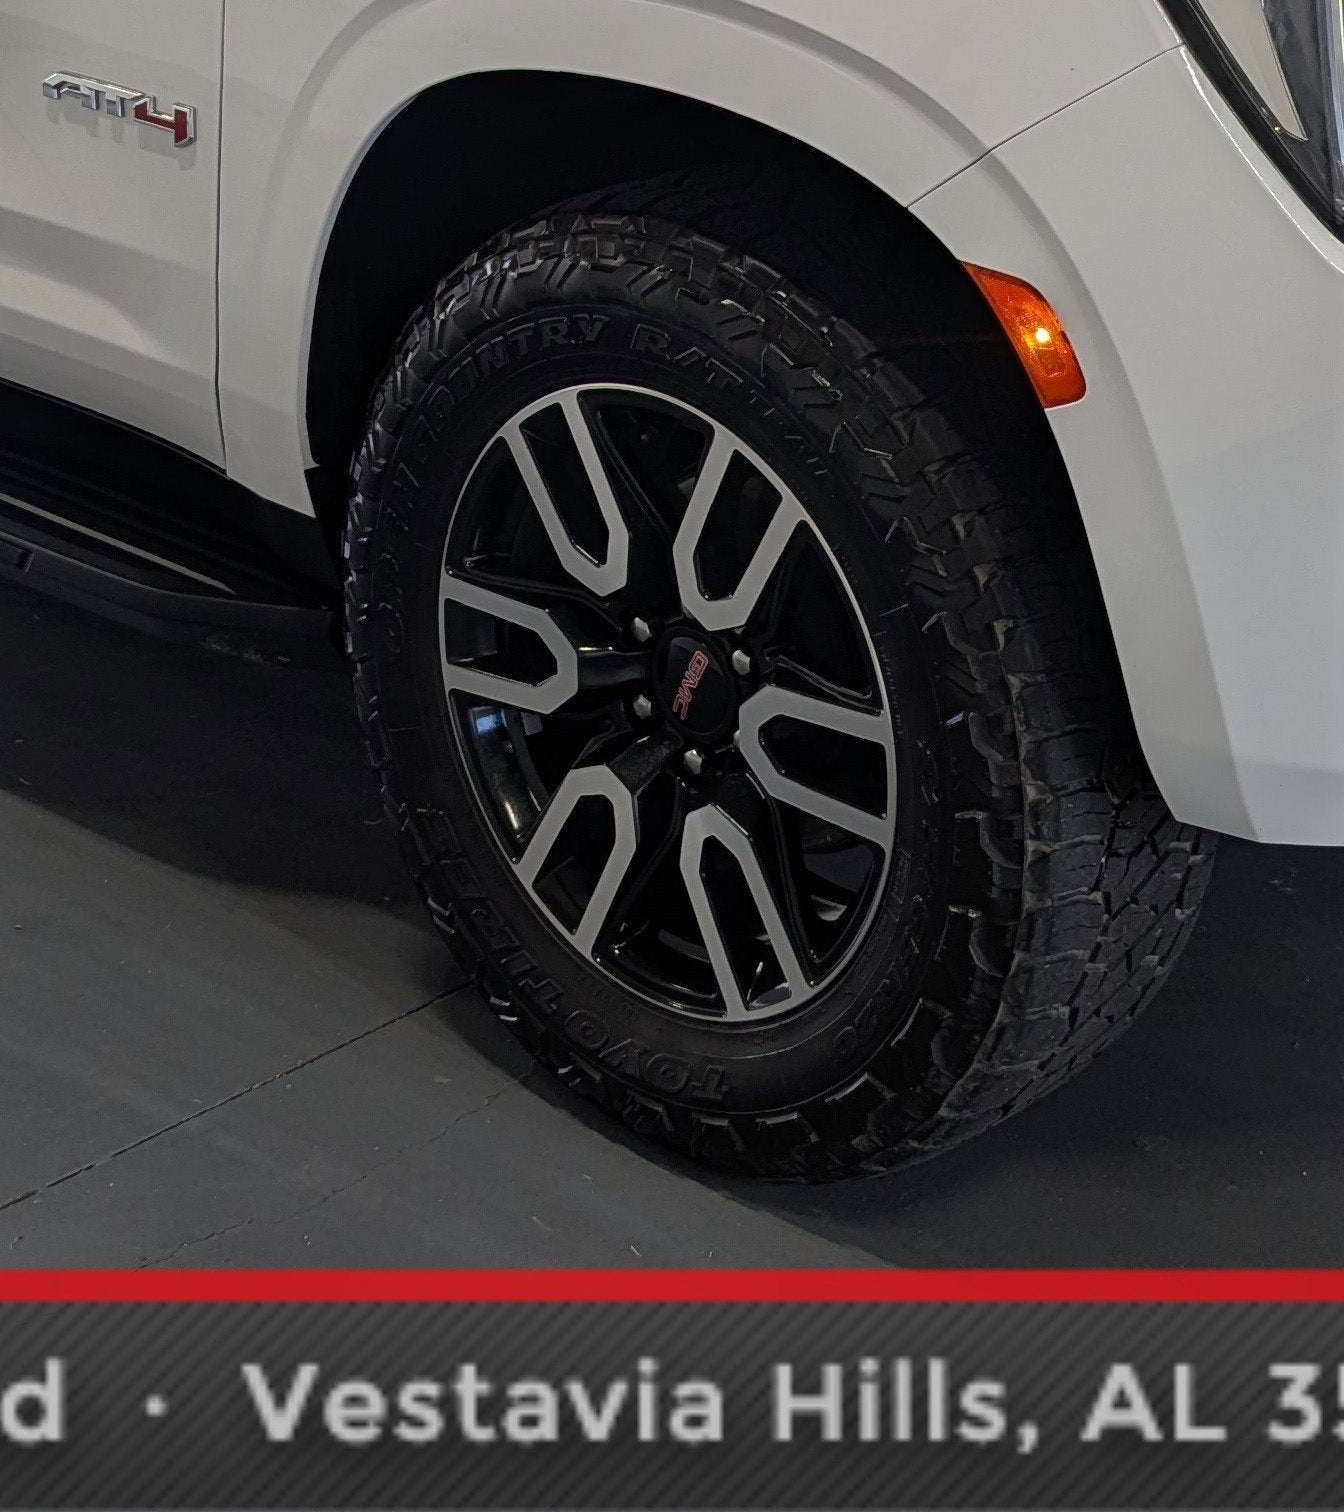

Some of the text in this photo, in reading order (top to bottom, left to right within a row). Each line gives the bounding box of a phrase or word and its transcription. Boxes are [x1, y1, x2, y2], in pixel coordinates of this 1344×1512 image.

[42, 70, 197, 148] AT4
[672, 650, 709, 721] GMC
[563, 1008, 726, 1099] TOYO
